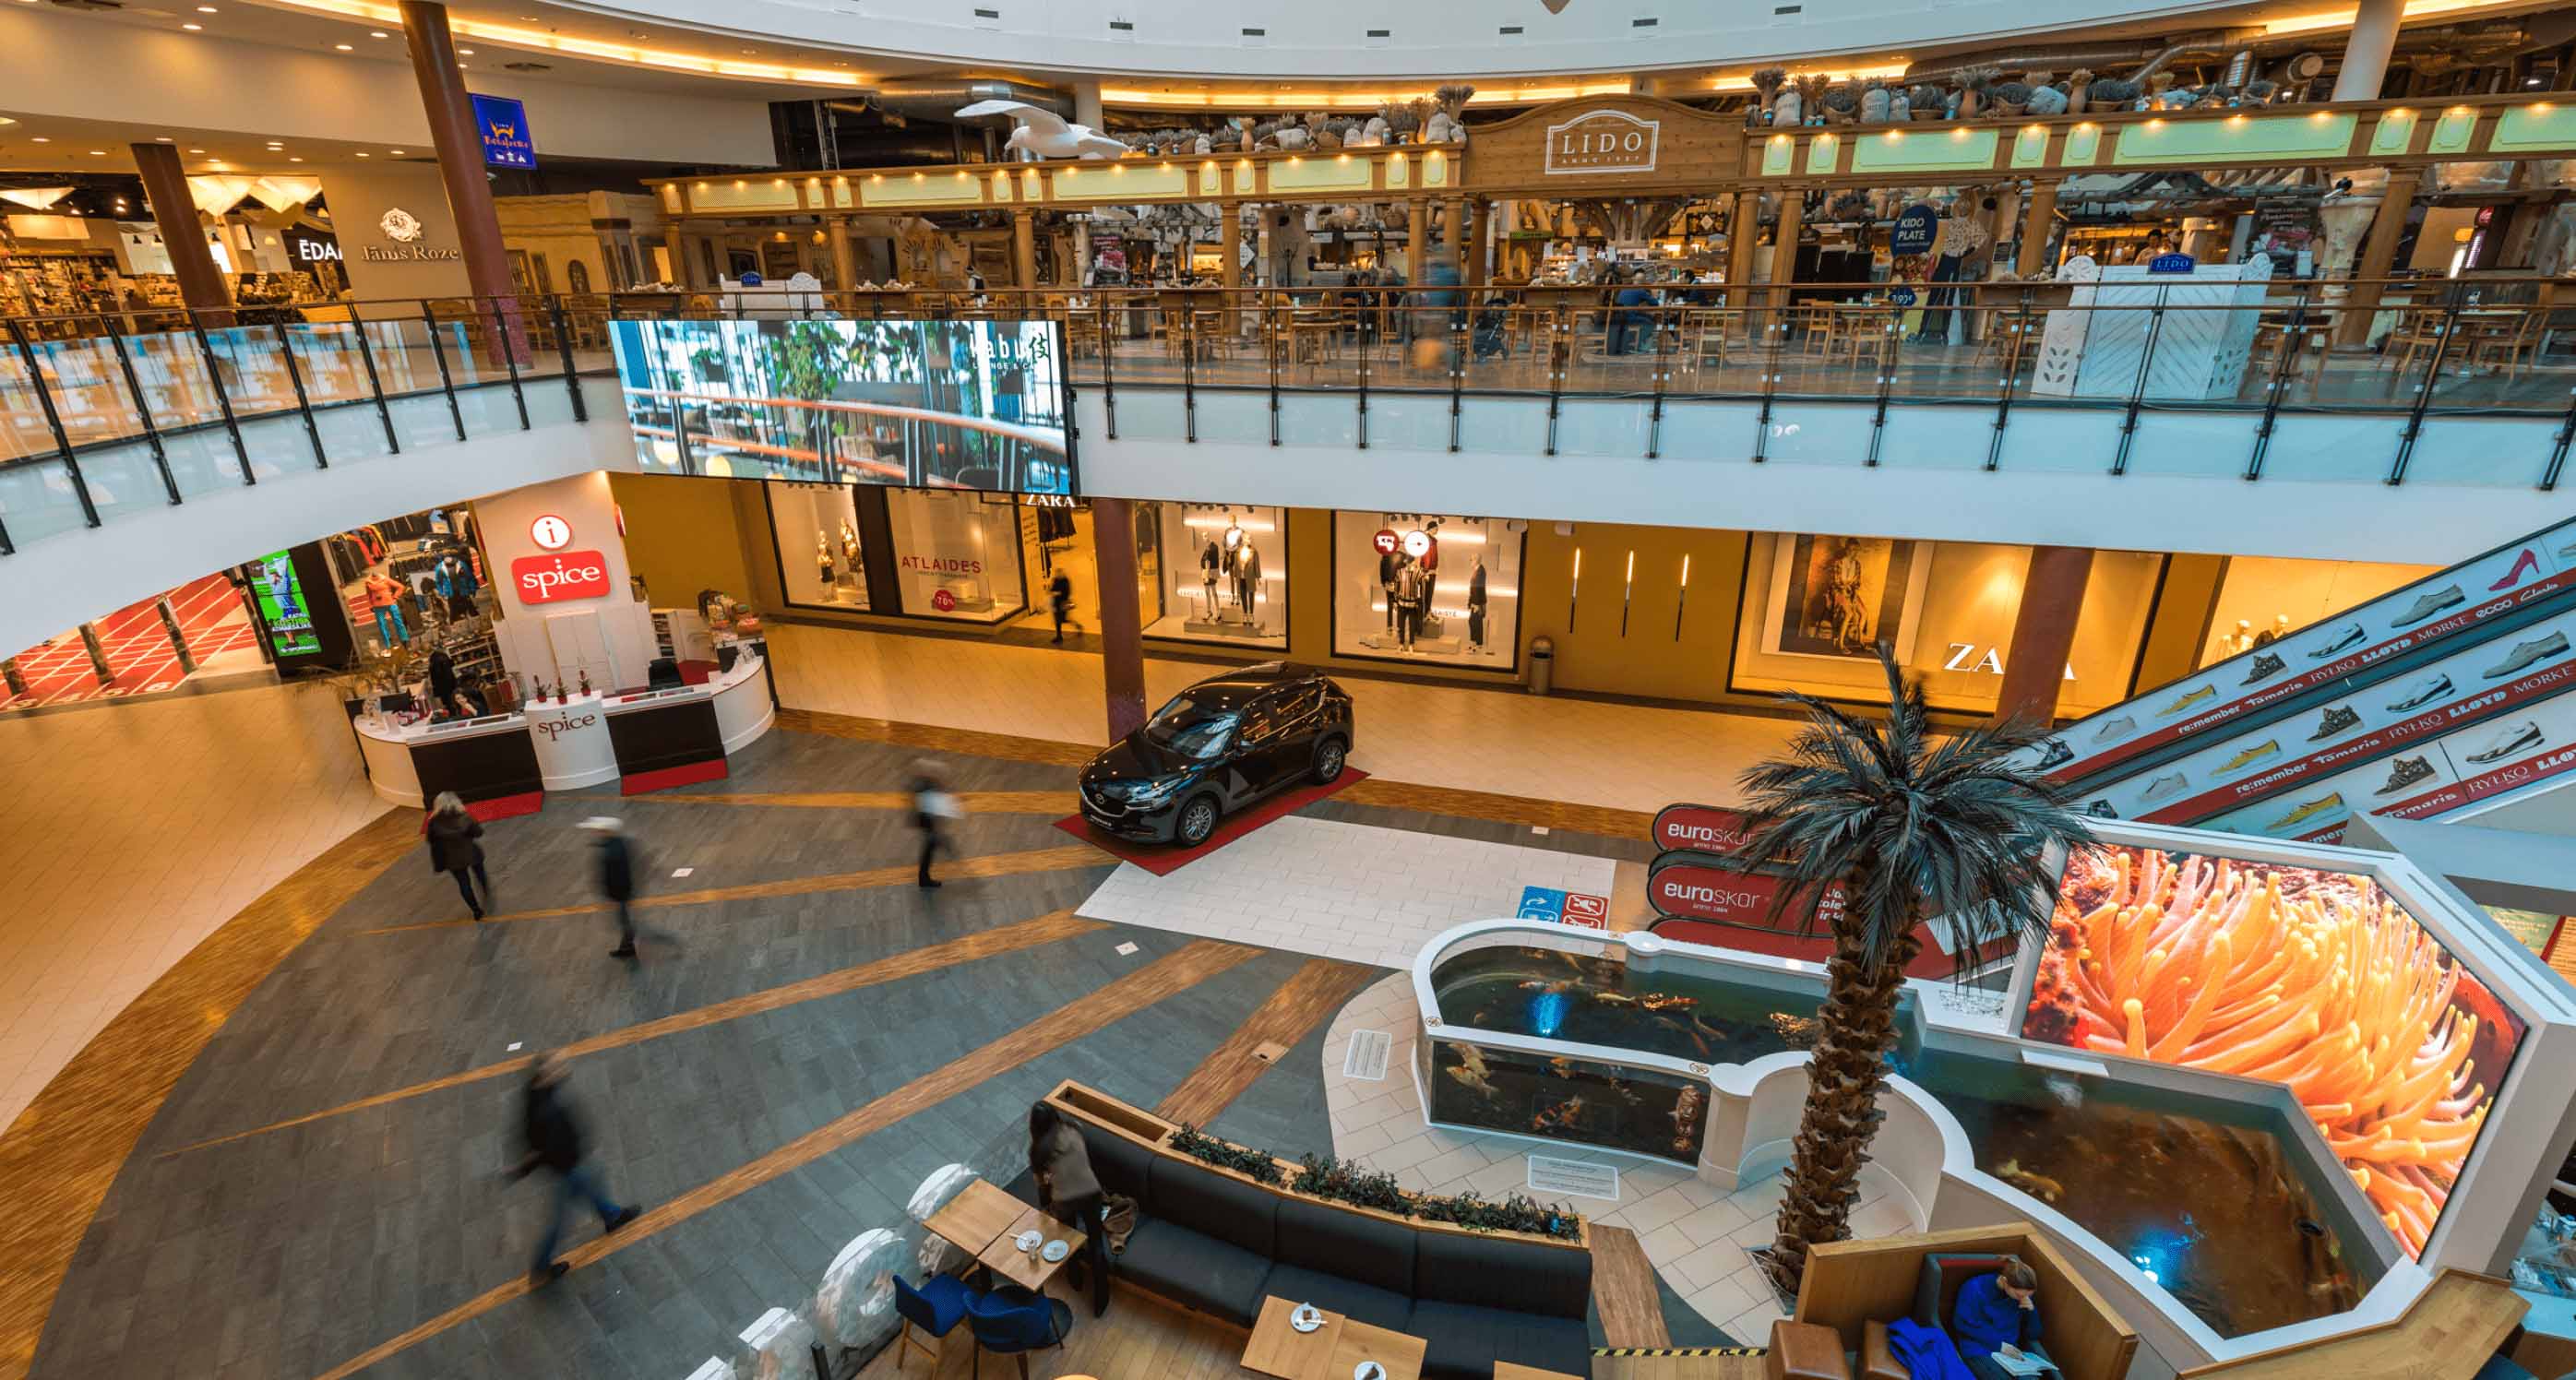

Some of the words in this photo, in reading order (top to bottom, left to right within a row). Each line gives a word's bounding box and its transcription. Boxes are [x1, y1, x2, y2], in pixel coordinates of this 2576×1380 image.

[1563, 132, 1642, 155] LIDO
[1901, 217, 1926, 228] KIDO
[1897, 230, 1926, 241] PLATE
[361, 245, 409, 261] Jānis
[412, 244, 459, 260] Roze
[2156, 259, 2189, 268] LIDO
[1026, 494, 1076, 508] ZARA
[901, 556, 982, 574] ATLAIDES
[522, 558, 601, 599] spice
[2178, 705, 2241, 734] re:member
[2245, 682, 2304, 708] Tamaris
[2361, 638, 2412, 663] LLOYD
[2416, 616, 2468, 641] MORKE
[2475, 599, 2513, 618] ecco
[2520, 583, 2558, 602] Clarks
[538, 711, 596, 742] spice
[2236, 763, 2308, 793] re:member
[2312, 737, 2380, 764] Tamaris
[2449, 690, 2507, 718] LLOYD
[2514, 665, 2571, 694] MORKE
